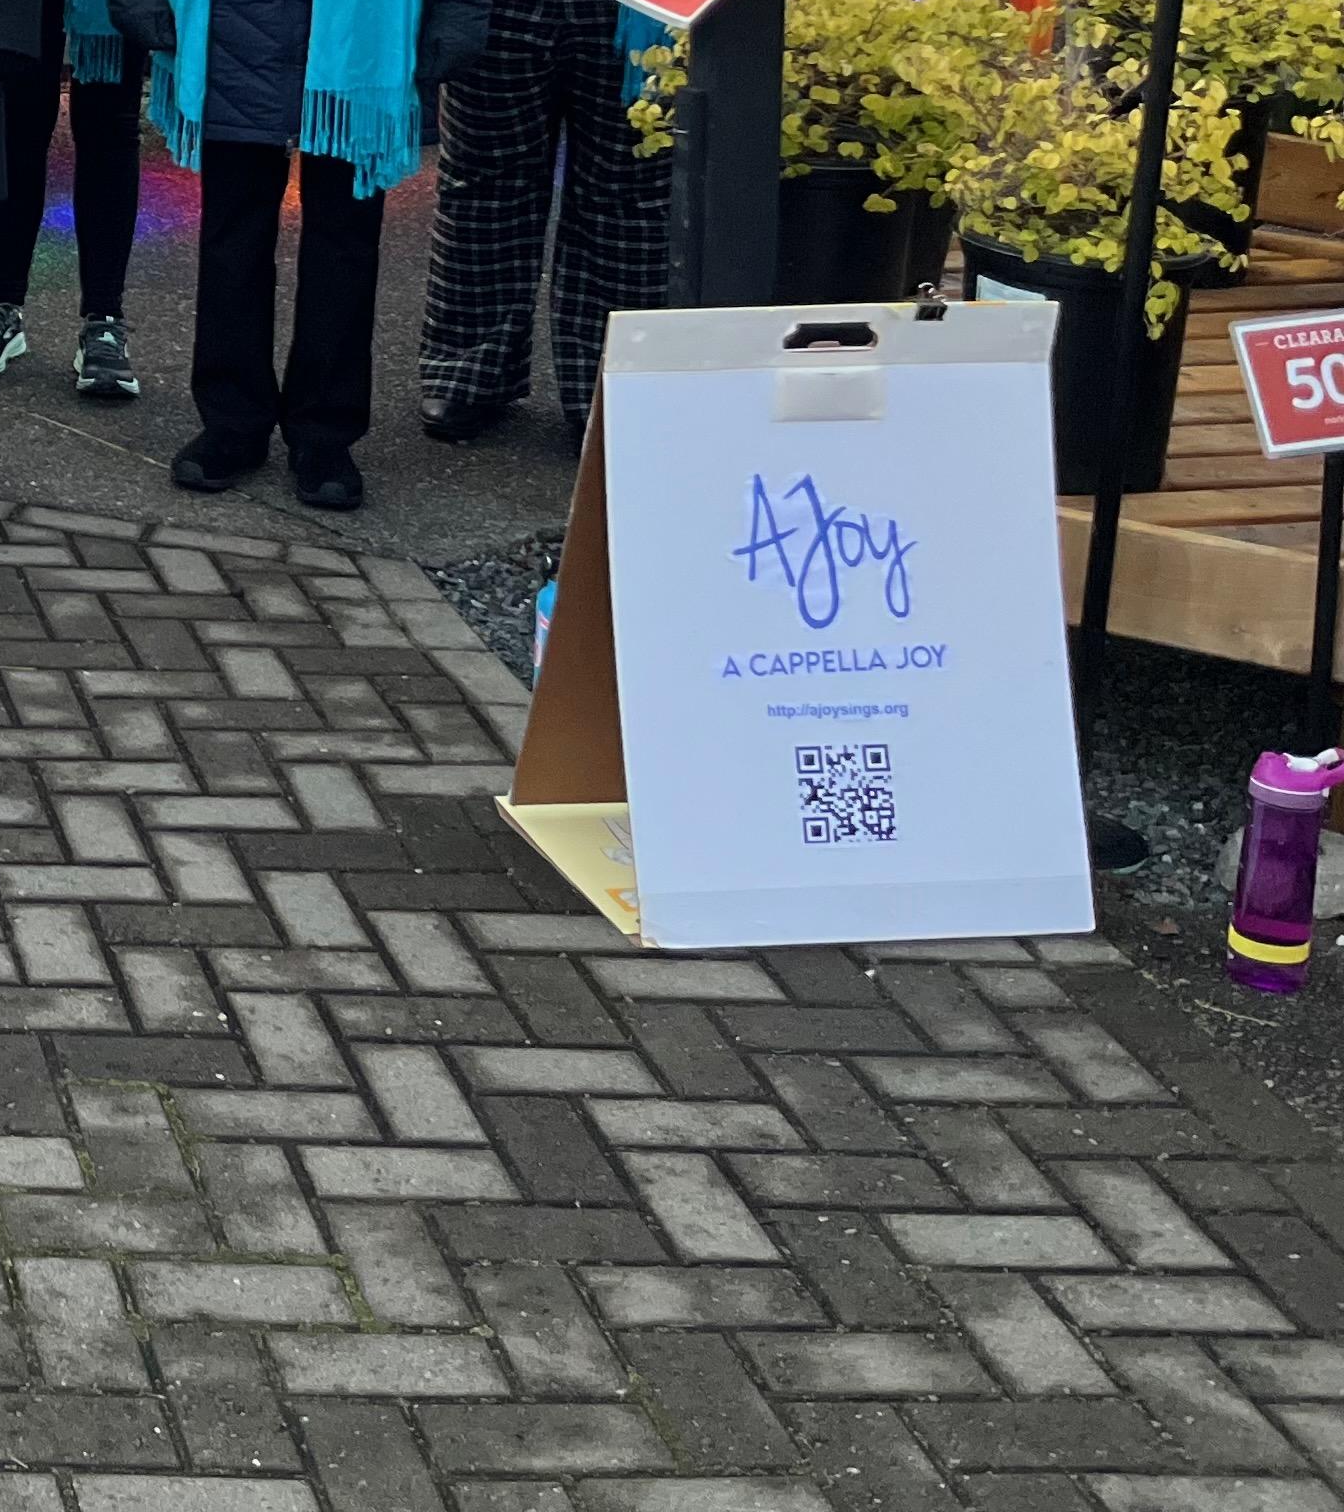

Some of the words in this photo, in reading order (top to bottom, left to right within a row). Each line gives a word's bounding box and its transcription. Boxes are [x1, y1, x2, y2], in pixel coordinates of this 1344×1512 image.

[722, 655, 742, 678] A
[749, 649, 888, 677] CAPPELLA
[896, 644, 948, 670] JOY
[767, 702, 910, 720] http://ajoysings.org
